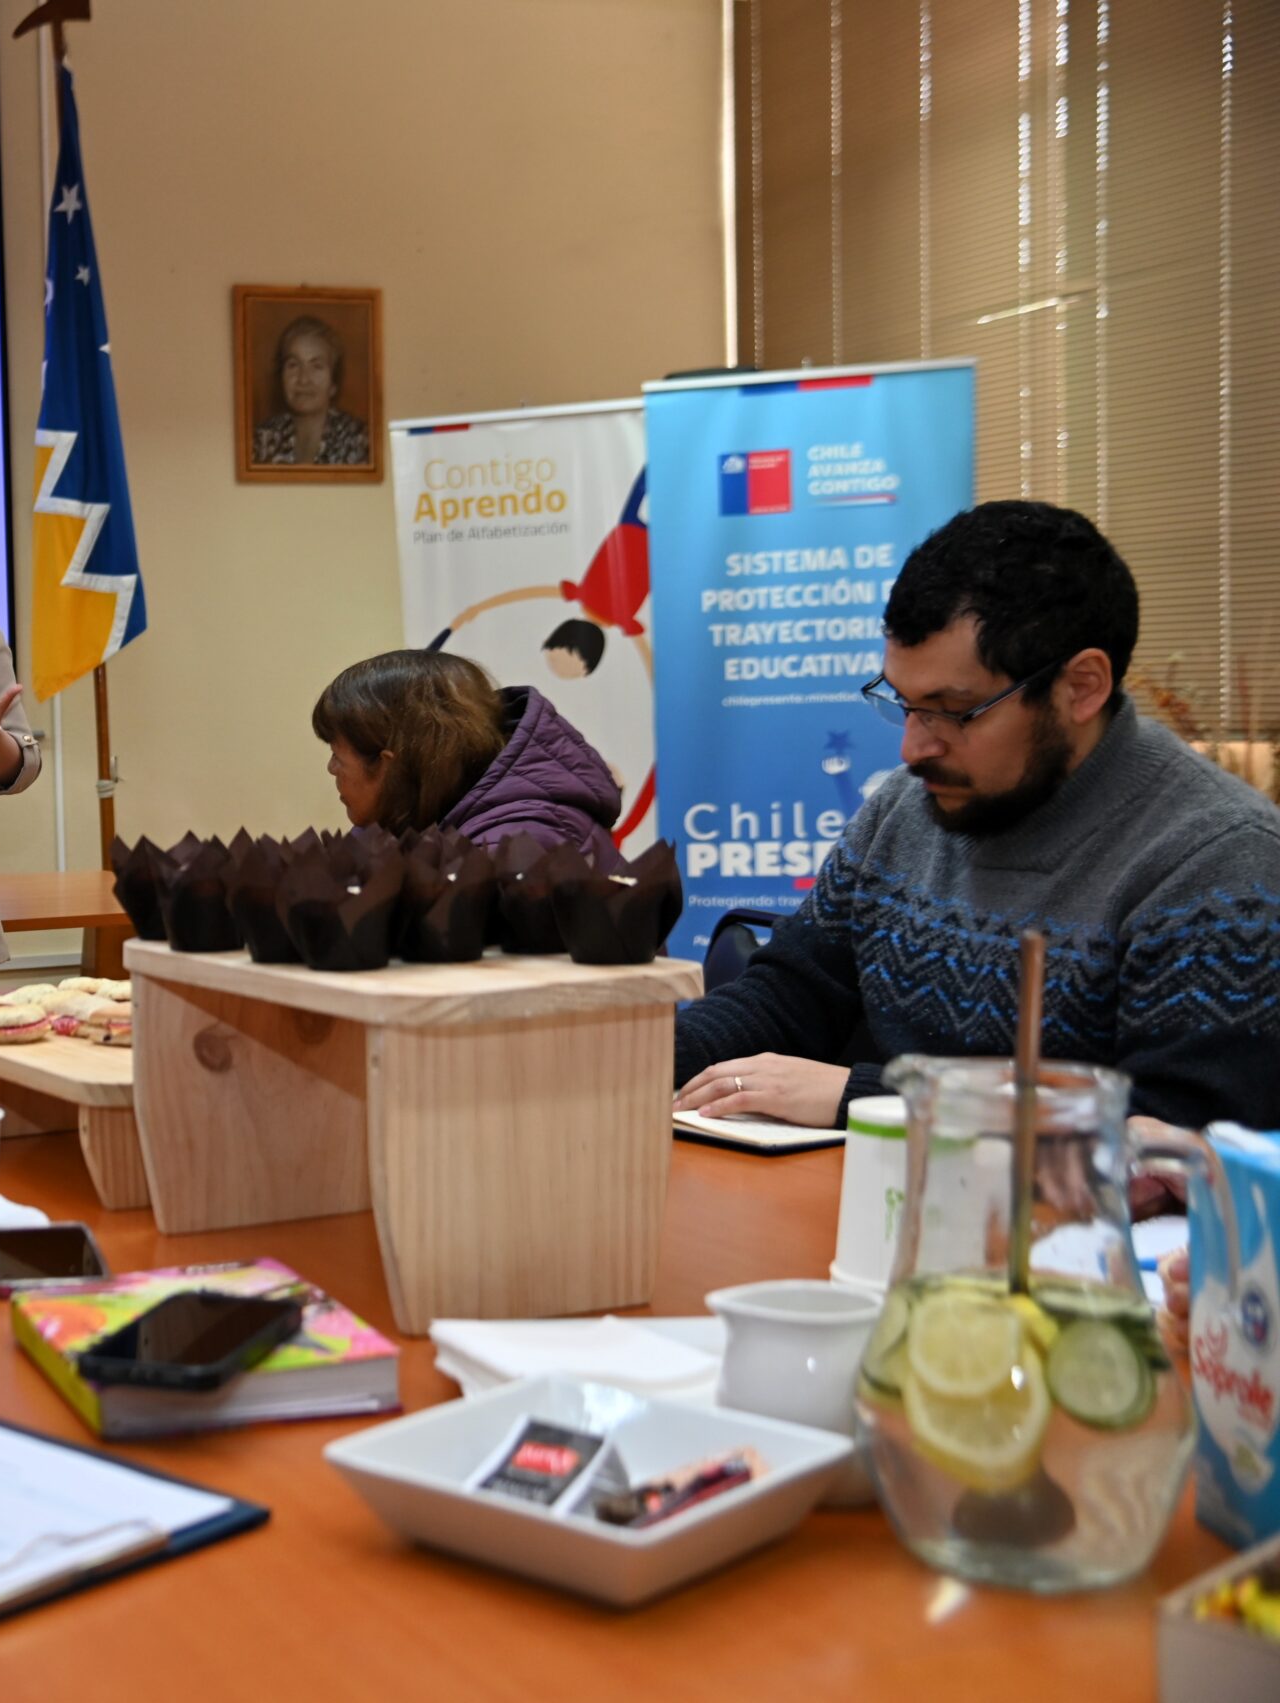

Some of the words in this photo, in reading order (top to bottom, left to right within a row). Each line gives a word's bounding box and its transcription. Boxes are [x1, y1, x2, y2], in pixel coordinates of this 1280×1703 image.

[807, 442, 864, 461] CHILE
[423, 455, 556, 491] Contigo
[807, 459, 886, 479] AVANZA
[808, 475, 901, 496] CONTIGO
[414, 484, 567, 528] Aprendo
[413, 532, 443, 545] Plan
[447, 529, 465, 542] de
[468, 522, 569, 541] Alfabetización
[725, 548, 847, 576] SISTEMA
[854, 544, 894, 570] DE
[701, 578, 874, 612] PROTECCIÓN
[684, 802, 845, 841] Chile
[688, 895, 773, 907] Protegiendo
